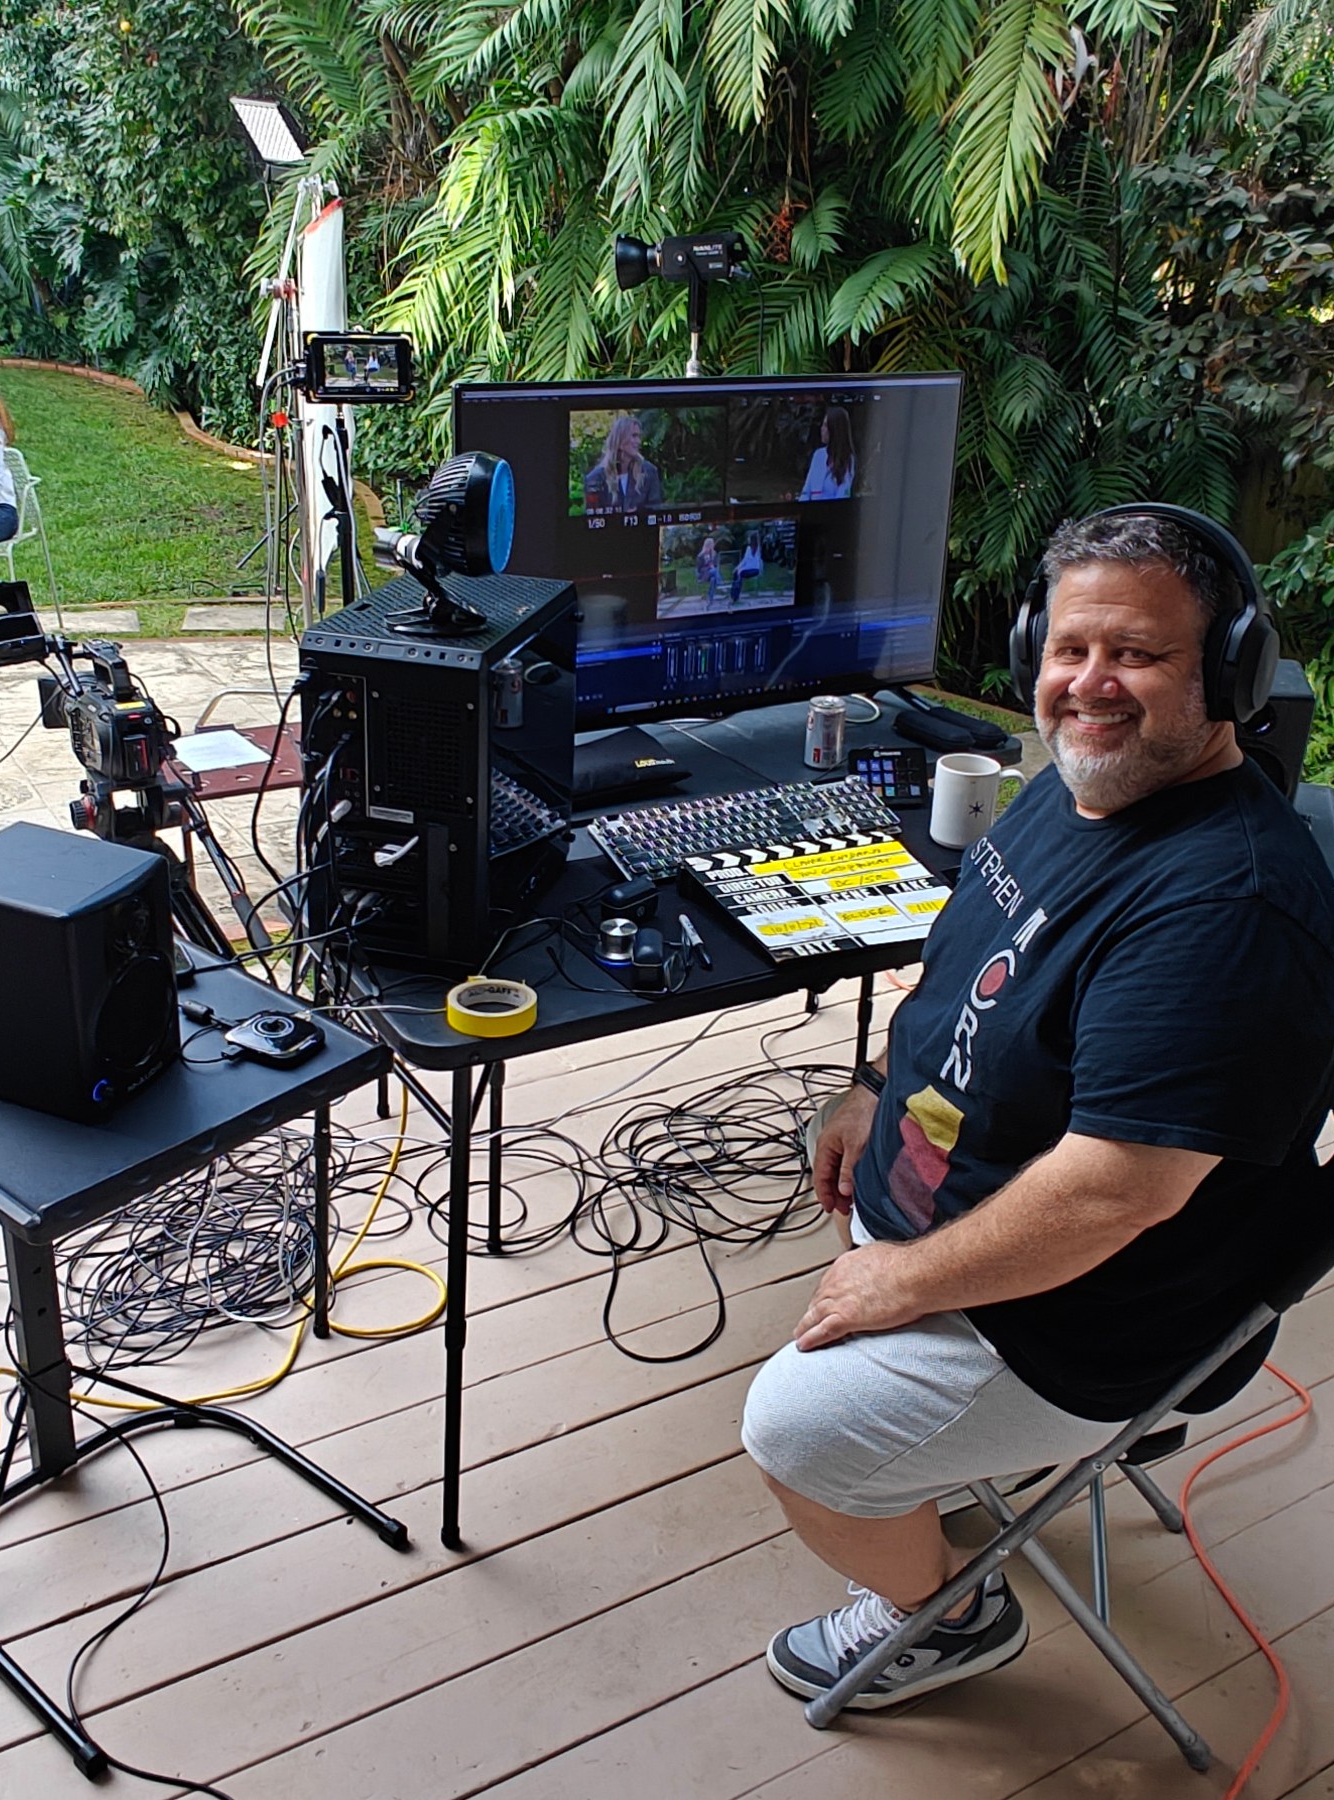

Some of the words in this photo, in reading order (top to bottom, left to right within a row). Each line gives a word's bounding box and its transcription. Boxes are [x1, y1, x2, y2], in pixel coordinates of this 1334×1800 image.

[717, 875, 786, 893] DIRECTOR
[888, 877, 936, 893] TAKE
[732, 888, 793, 904] CAMERA
[821, 887, 872, 904] SCENE
[790, 940, 842, 957] DATE
